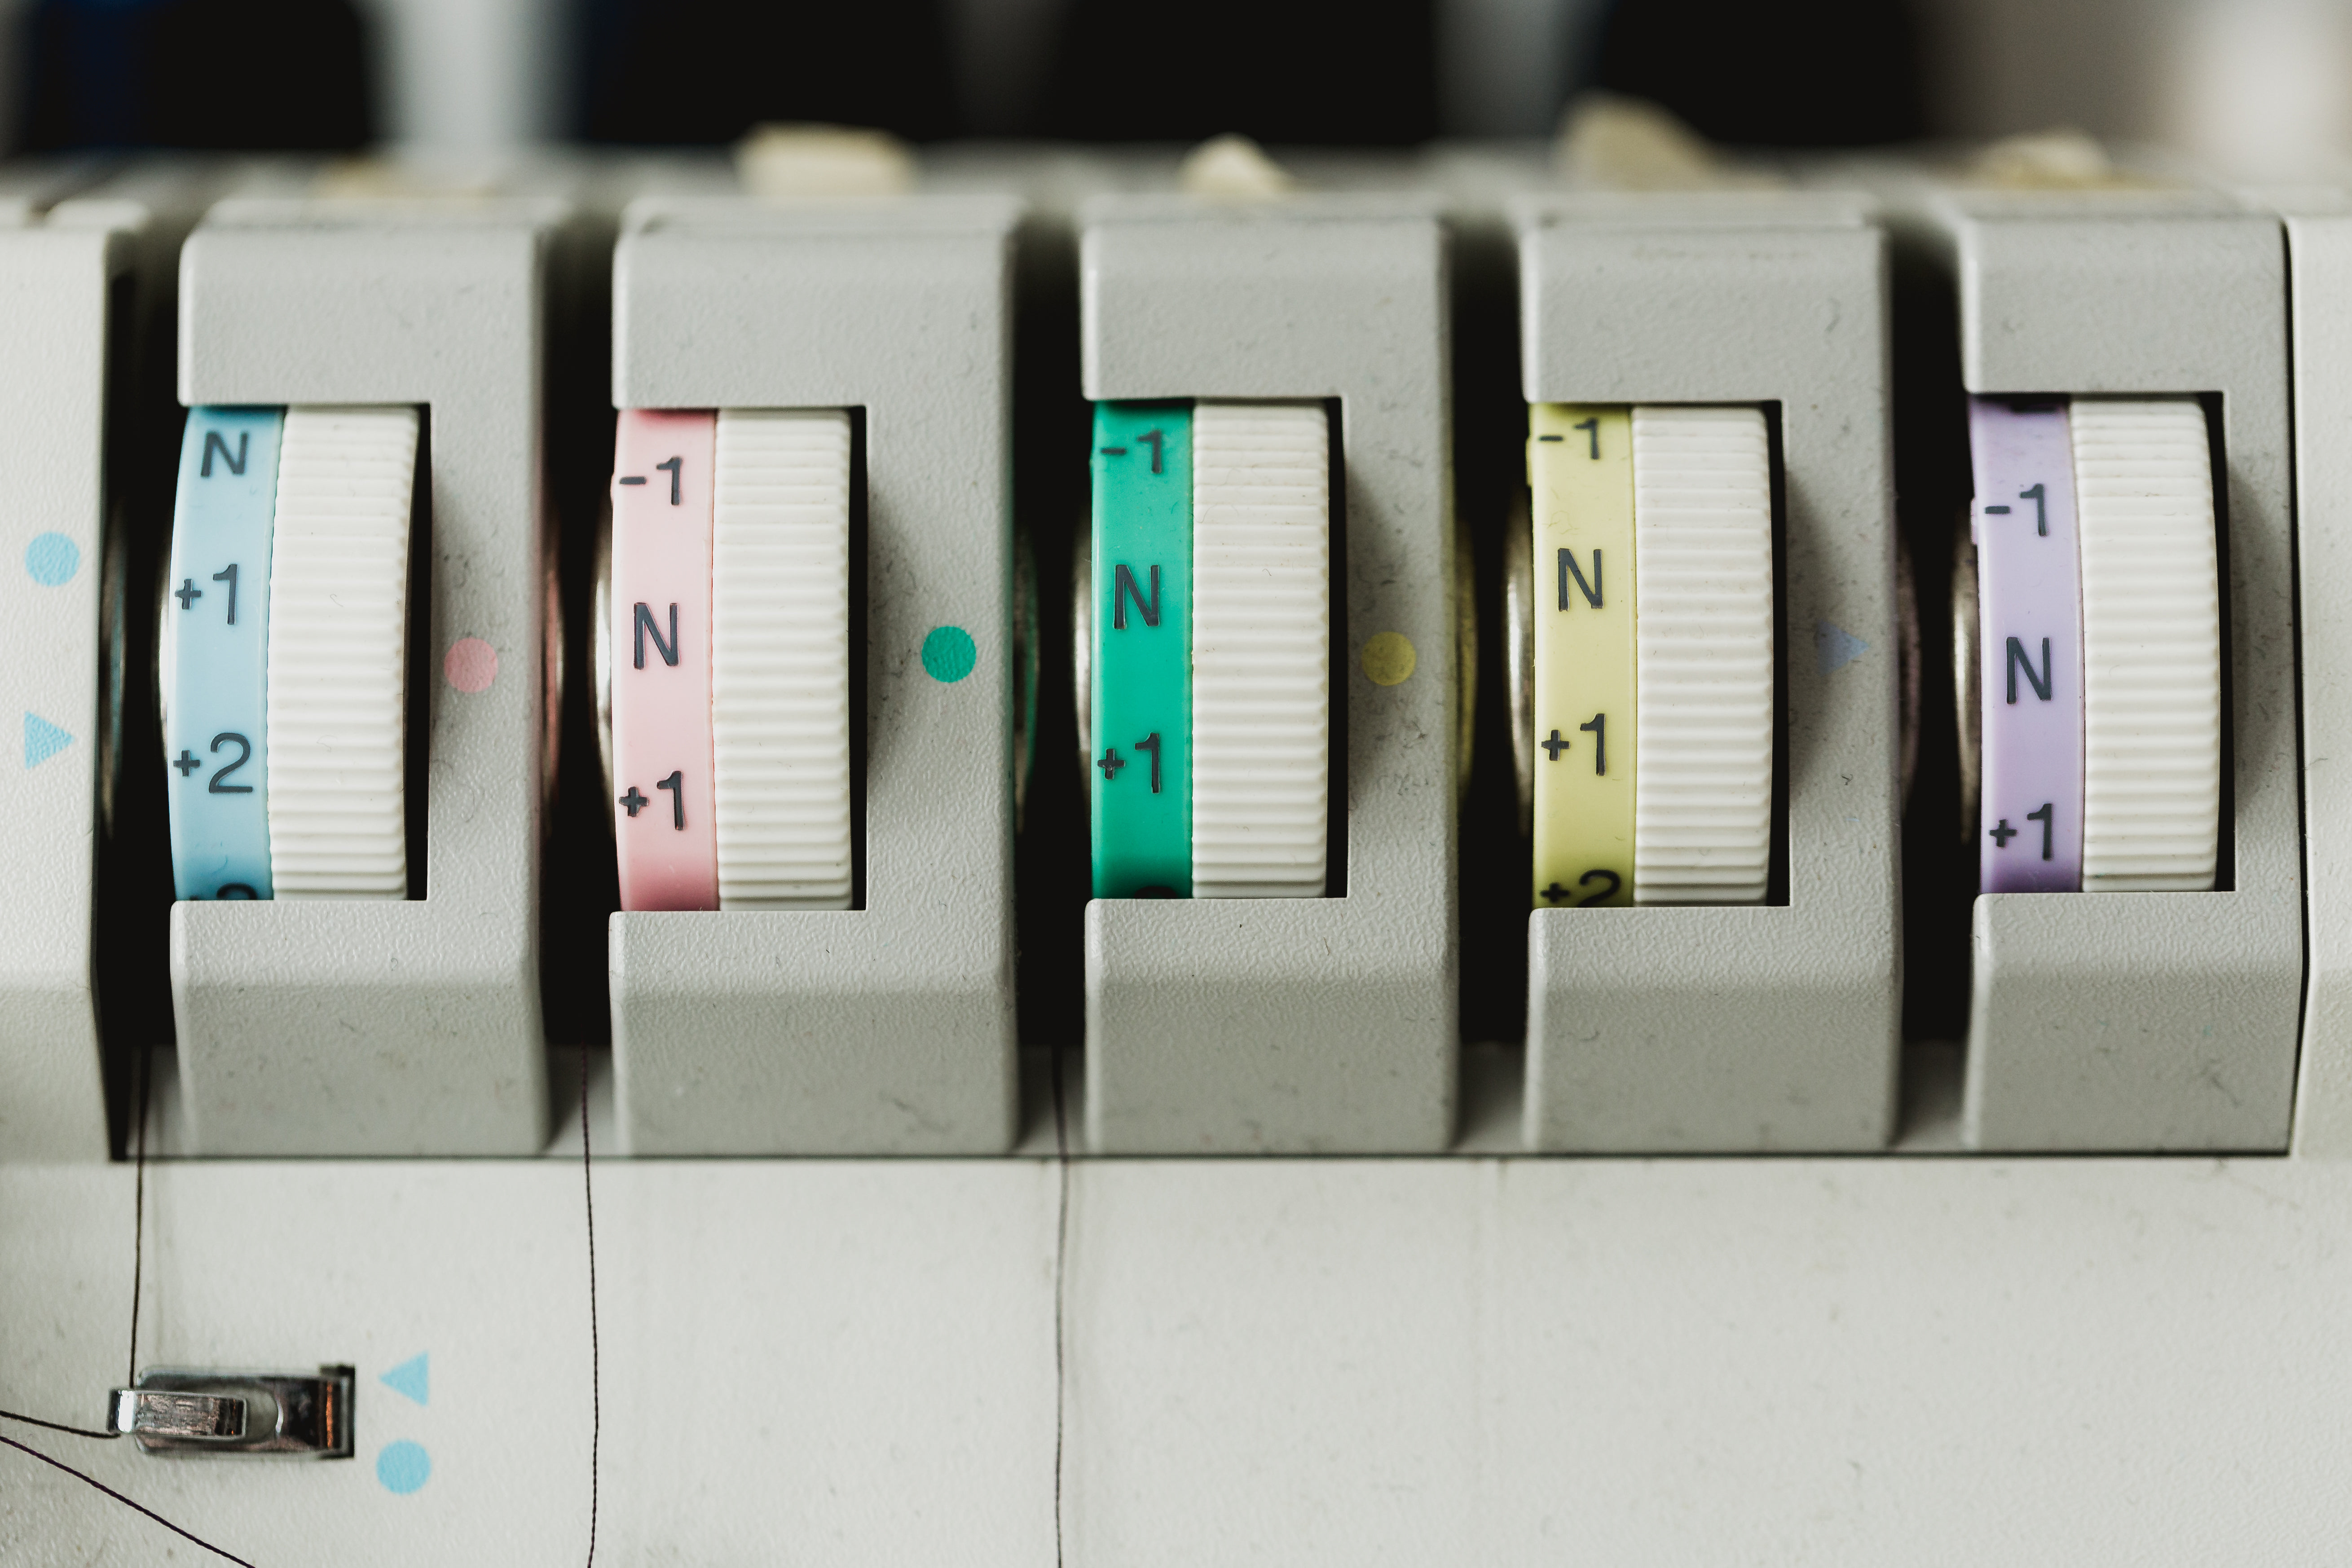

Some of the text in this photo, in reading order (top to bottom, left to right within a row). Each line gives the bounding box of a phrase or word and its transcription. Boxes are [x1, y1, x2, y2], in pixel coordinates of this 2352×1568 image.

[200, 429, 250, 479] N
[1100, 427, 1163, 474] -1
[1538, 417, 1601, 460] -1
[619, 455, 683, 507] -1
[1984, 482, 2048, 537] -1
[175, 563, 238, 626] +1
[1113, 564, 1161, 630] N
[1557, 547, 1603, 613] N
[634, 602, 679, 670] N
[2005, 636, 2052, 705] N
[173, 731, 253, 794] +2
[1097, 732, 1160, 794] +1
[1541, 713, 1607, 776] +1
[618, 770, 686, 831] +1
[1988, 802, 2053, 861] +1
